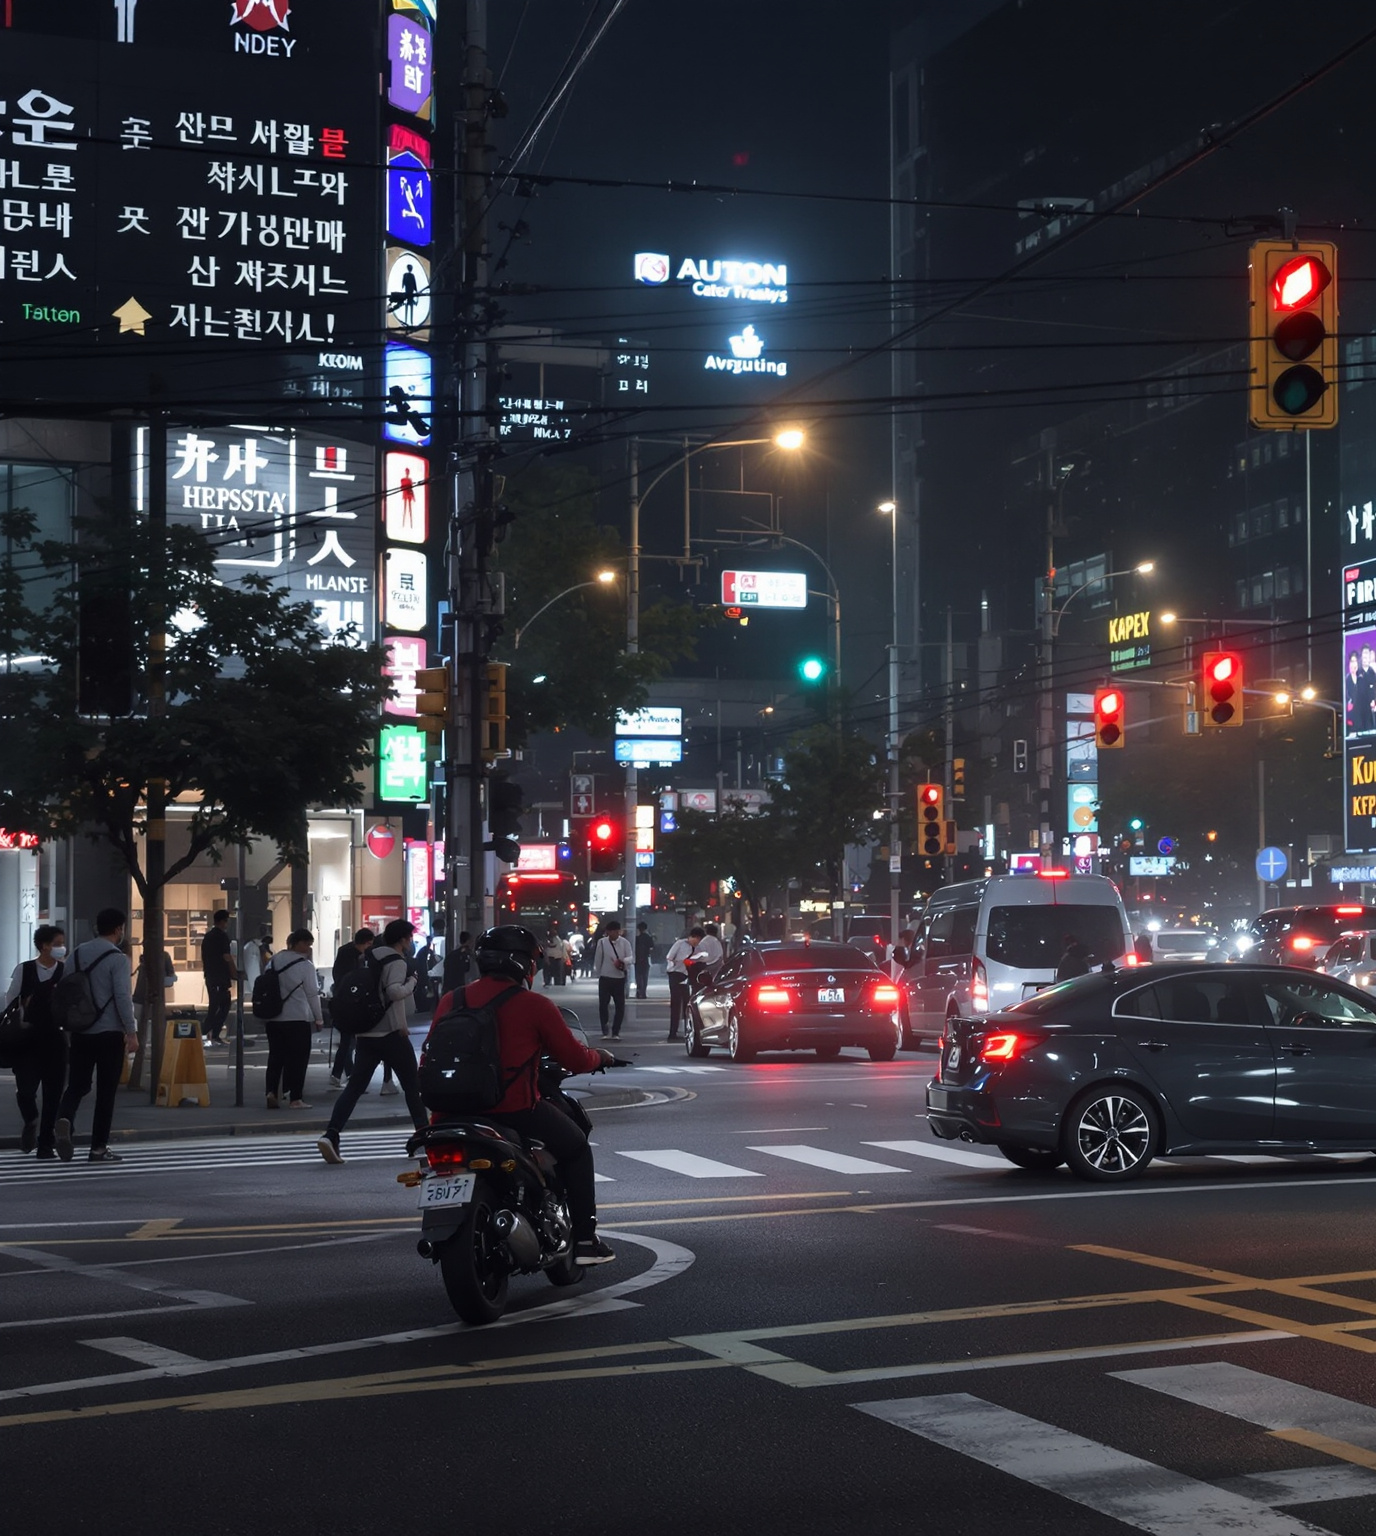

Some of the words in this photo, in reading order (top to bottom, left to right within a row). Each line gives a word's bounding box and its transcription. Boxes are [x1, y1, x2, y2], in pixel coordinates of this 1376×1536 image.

[235, 33, 297, 58] NDEY
[677, 258, 787, 286] AUTON
[1110, 611, 1150, 644] KAPEX
